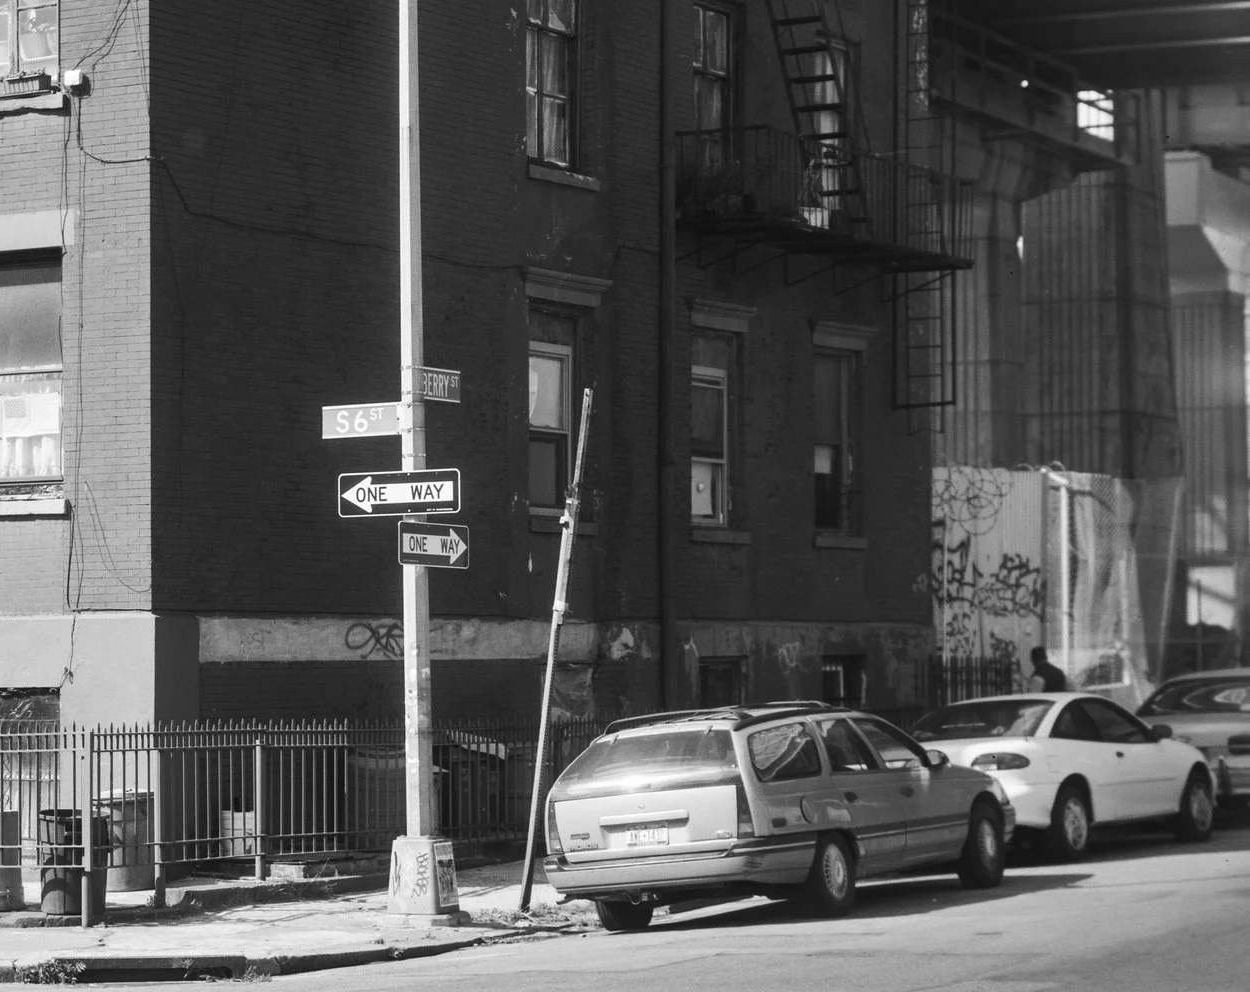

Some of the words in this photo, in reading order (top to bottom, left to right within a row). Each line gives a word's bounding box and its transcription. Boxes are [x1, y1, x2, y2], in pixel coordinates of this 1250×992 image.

[423, 373, 450, 397] BERRY
[450, 376, 459, 388] ST
[336, 410, 349, 433] S
[354, 411, 368, 432] 6
[369, 408, 385, 421] ST
[356, 486, 387, 503] ONE
[410, 484, 444, 501] WAY
[409, 536, 428, 552] ONE
[440, 538, 460, 554] WAY
